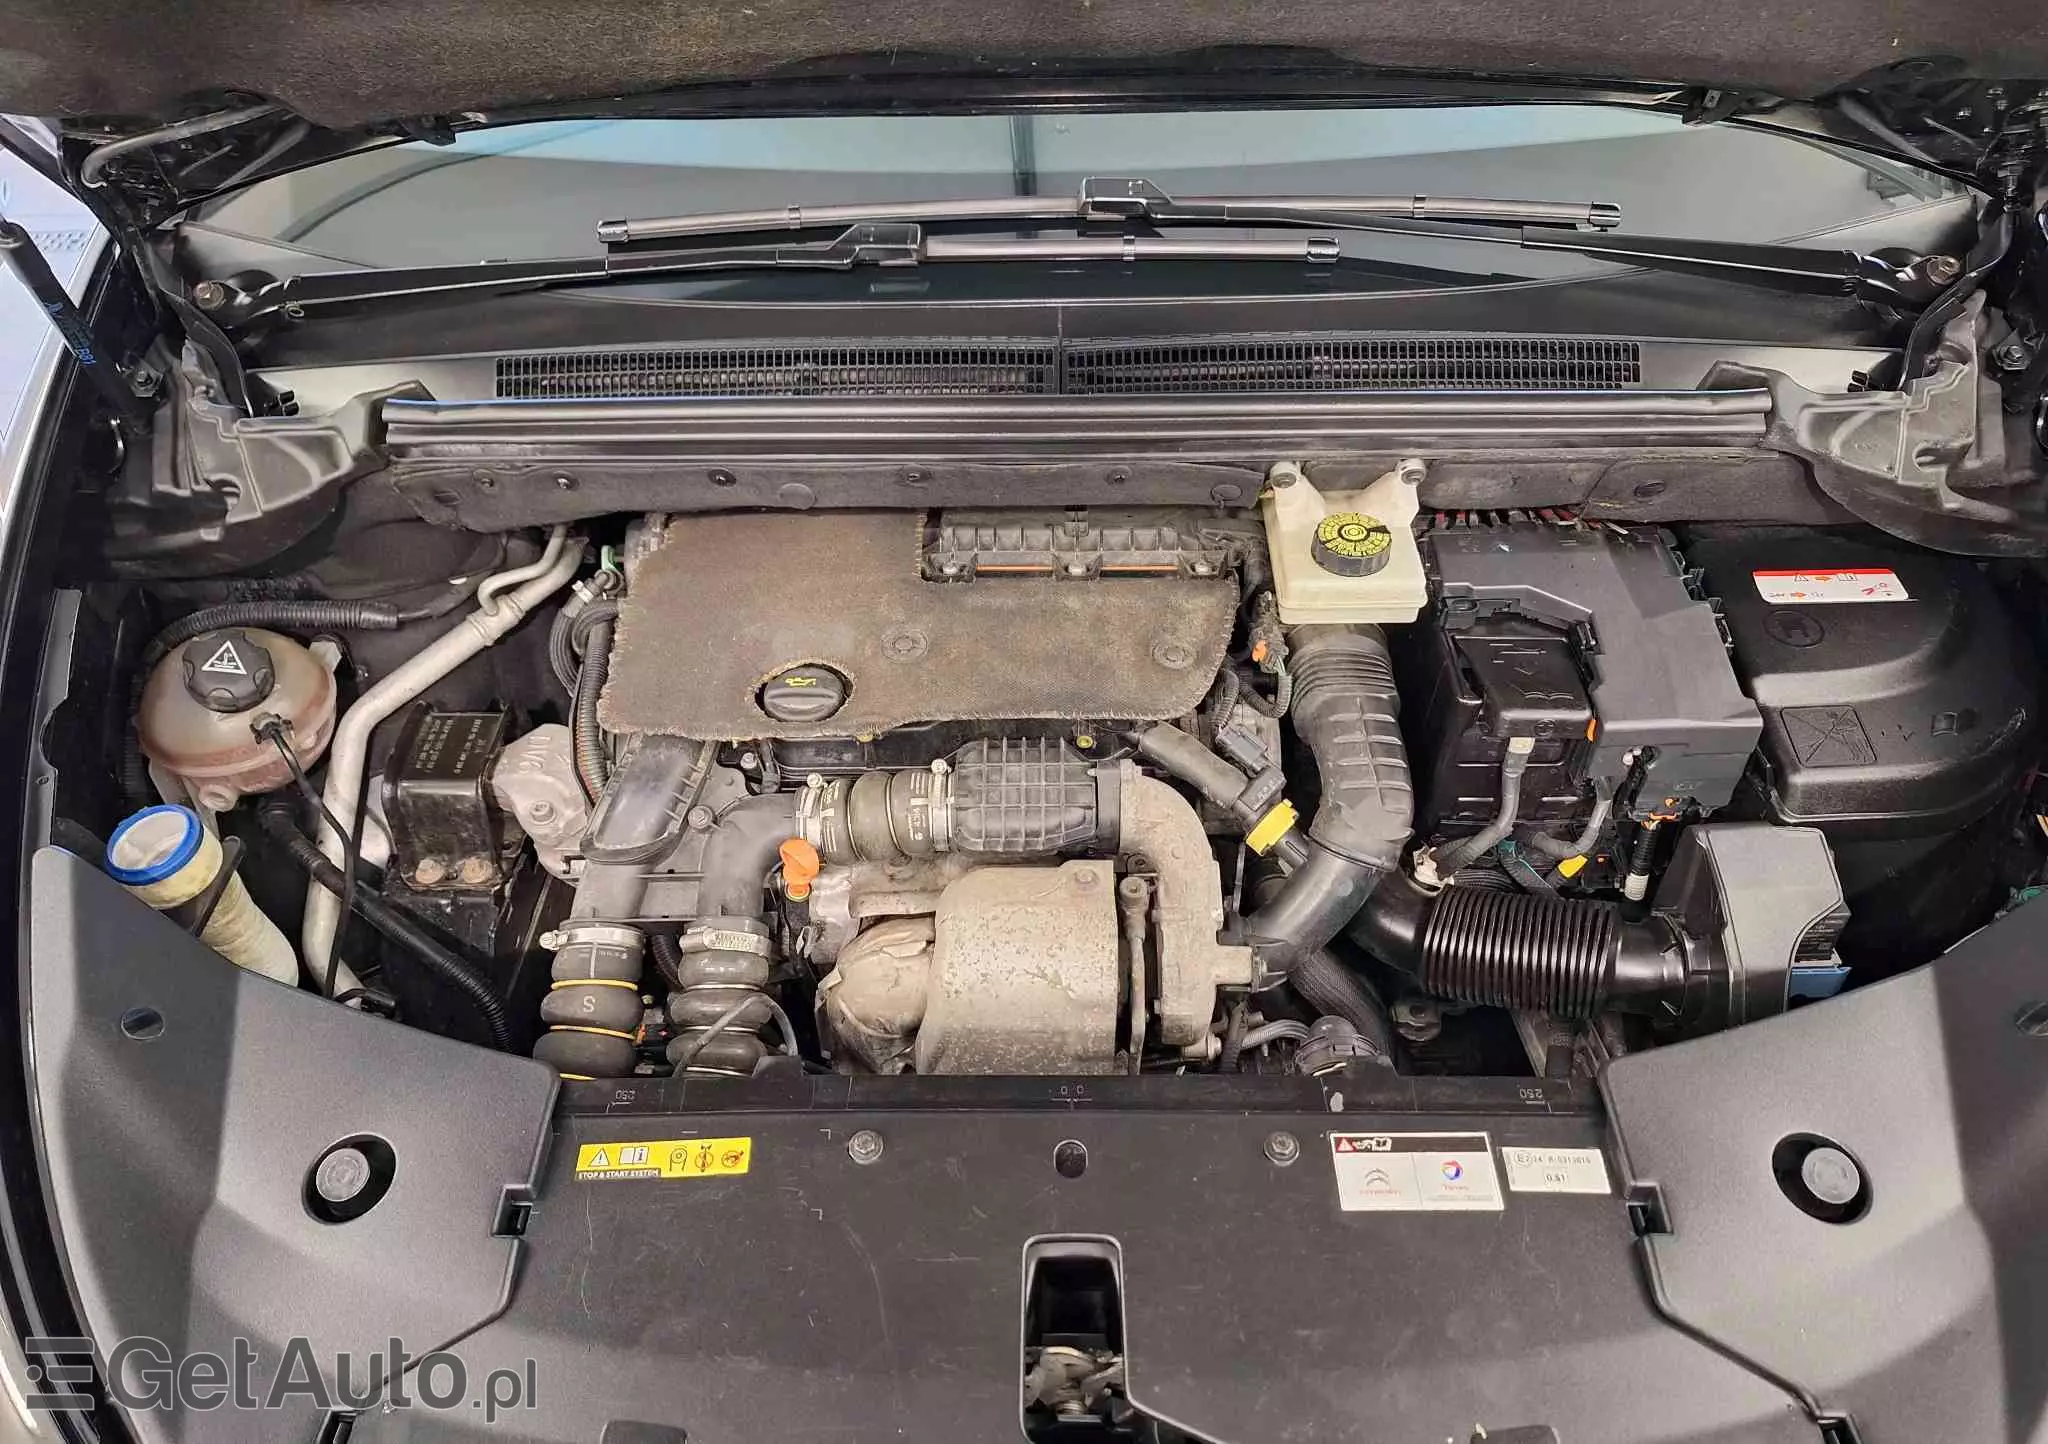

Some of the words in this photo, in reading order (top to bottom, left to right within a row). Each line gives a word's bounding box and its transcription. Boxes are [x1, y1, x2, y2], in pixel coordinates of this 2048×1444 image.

[583, 995, 596, 1013] S
[579, 1171, 599, 1180] STOP
[606, 1170, 629, 1178] START
[630, 1168, 659, 1177] SYSTEM
